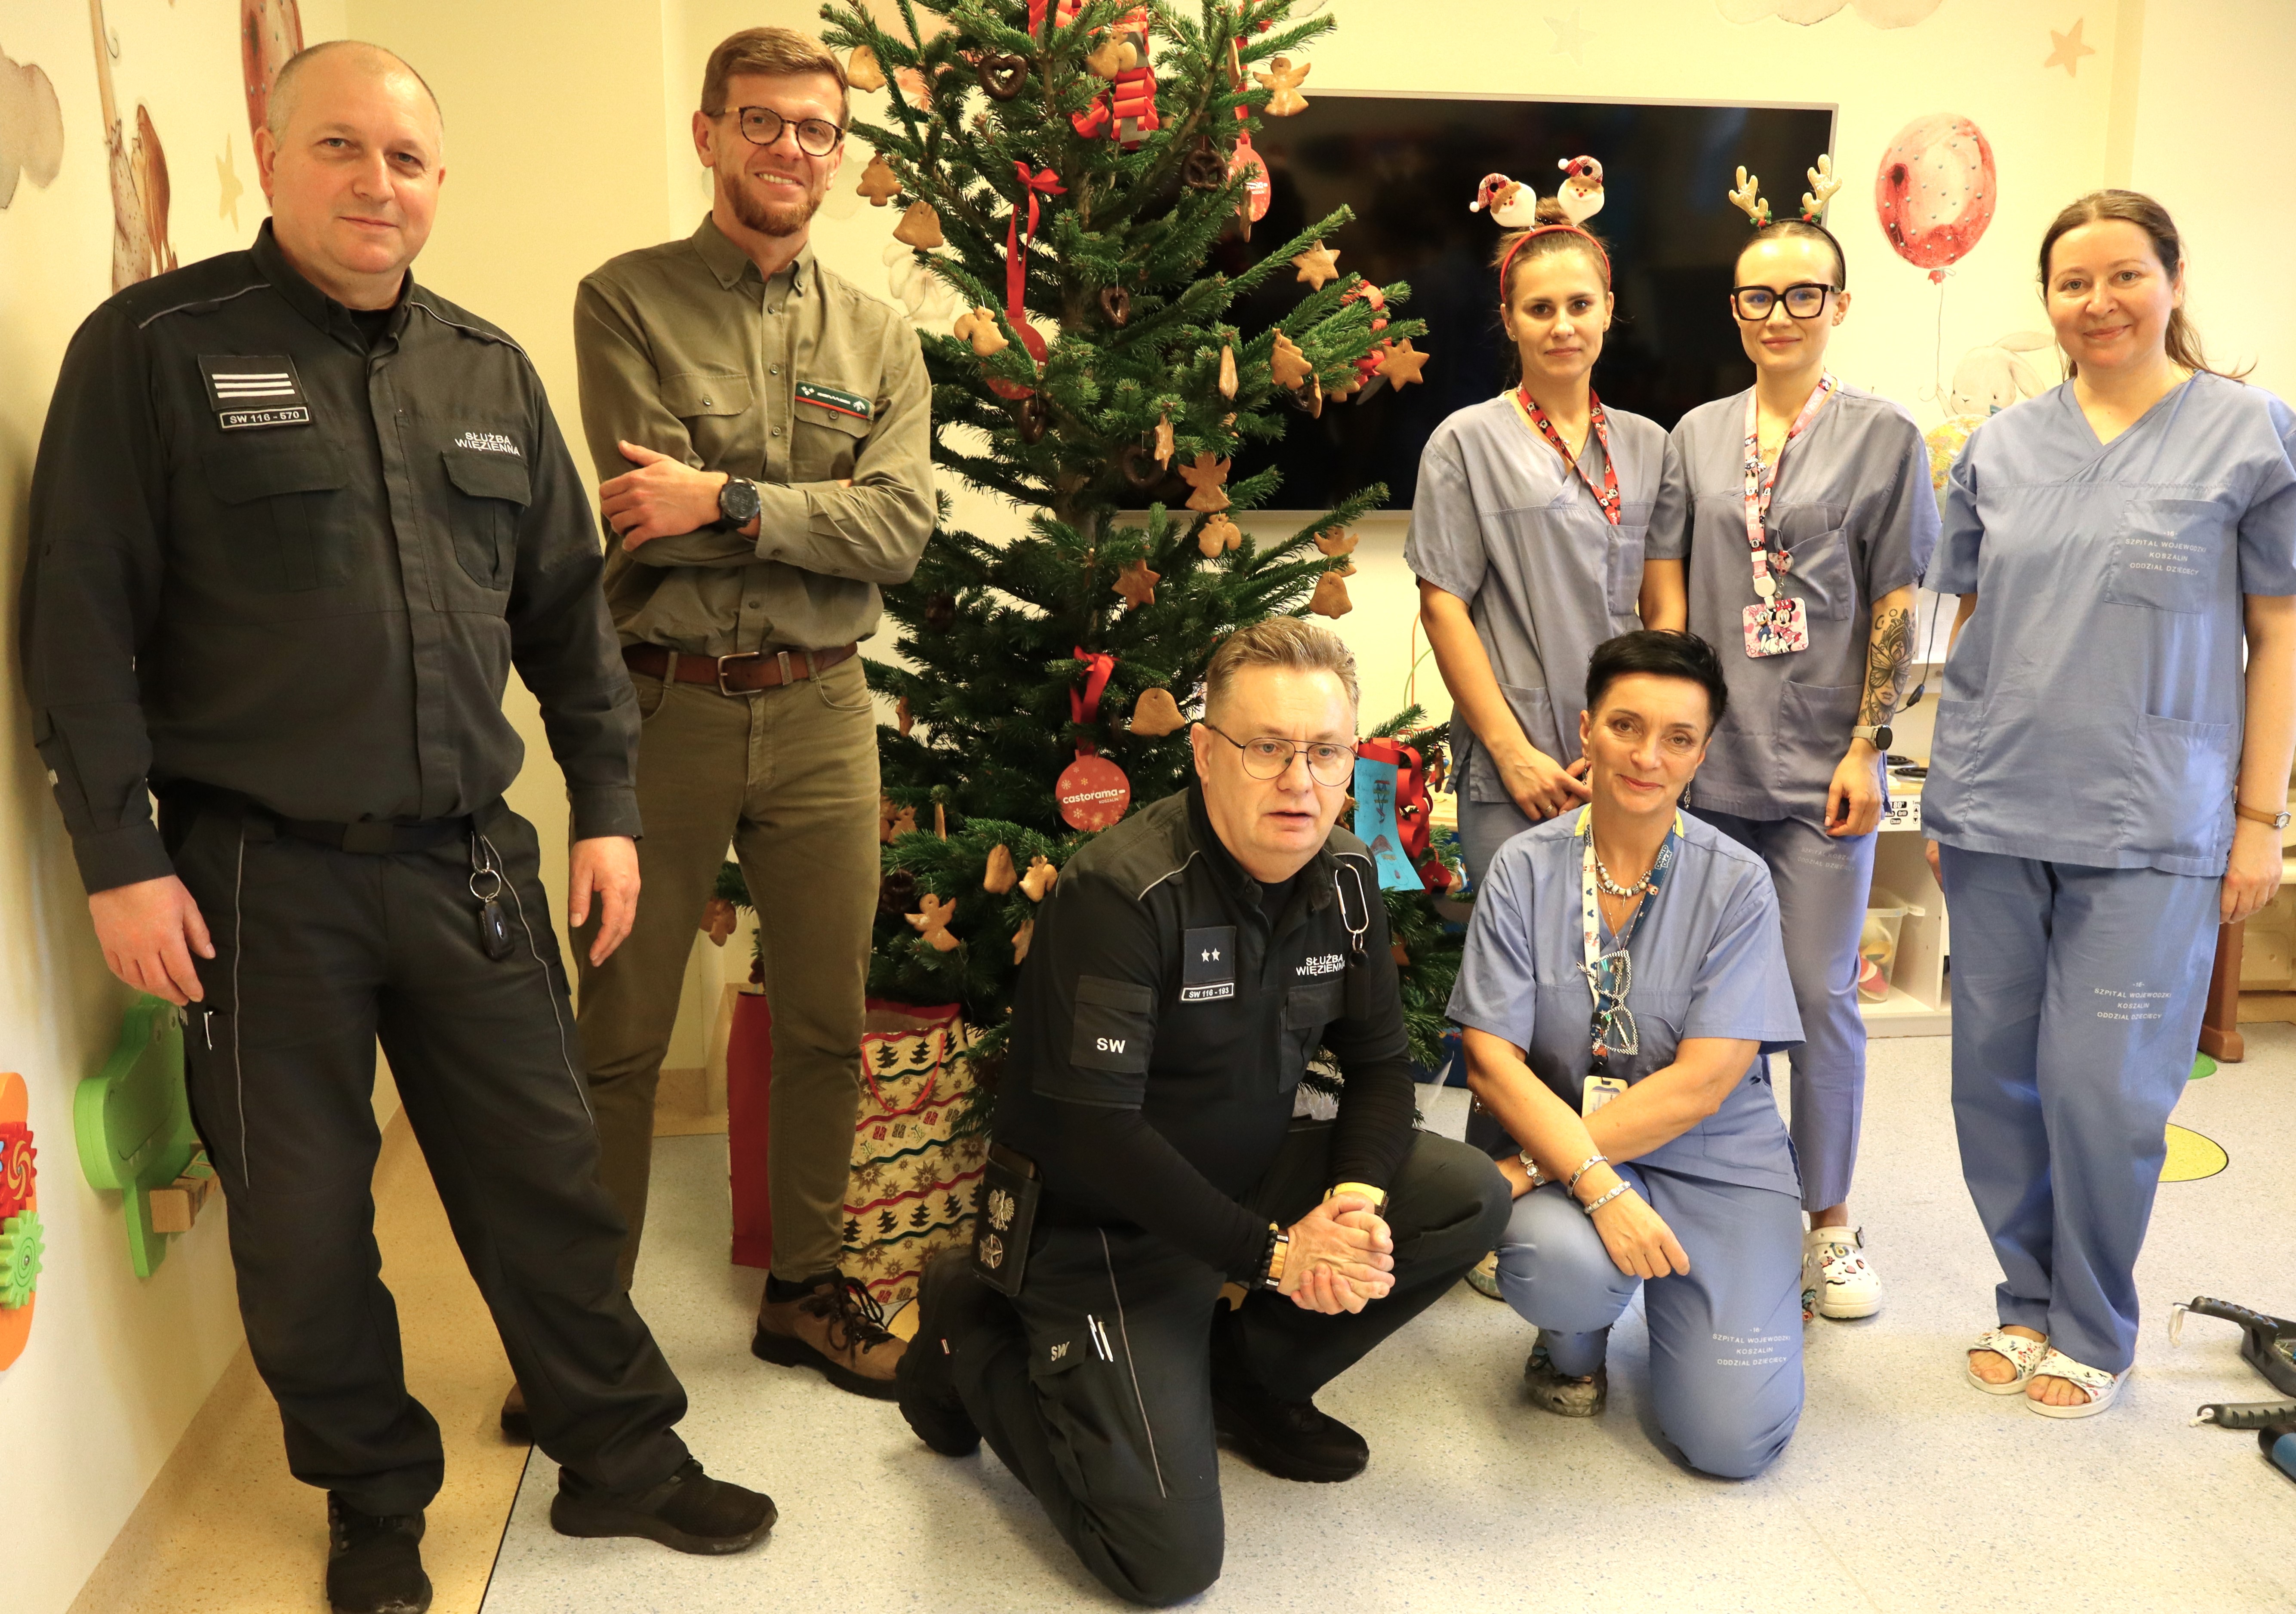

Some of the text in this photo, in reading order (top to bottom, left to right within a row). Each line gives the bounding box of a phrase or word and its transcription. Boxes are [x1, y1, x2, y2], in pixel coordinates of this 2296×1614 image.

[230, 415, 247, 424] SW
[250, 413, 270, 422] 116
[280, 411, 299, 420] 570
[465, 432, 511, 445] SŁUŻBA
[454, 438, 521, 456] WIĘZIENNA
[2125, 539, 2207, 553] SZPITAL WOJEWODZKI
[2149, 552, 2188, 562] KOSZALIN
[1063, 789, 1118, 804] castorama
[1655, 845, 1668, 869] DONALD
[1661, 850, 1672, 868] DUCK
[1305, 954, 1343, 966] SŁUŻBA
[1202, 989, 1213, 997] 116
[1219, 987, 1229, 995] 193
[2094, 988, 2127, 998] SZPITAL
[1096, 1038, 1126, 1053] SW
[1712, 1334, 1790, 1343] SZPITAL WOJEWODZKI
[1051, 1341, 1070, 1361] SW
